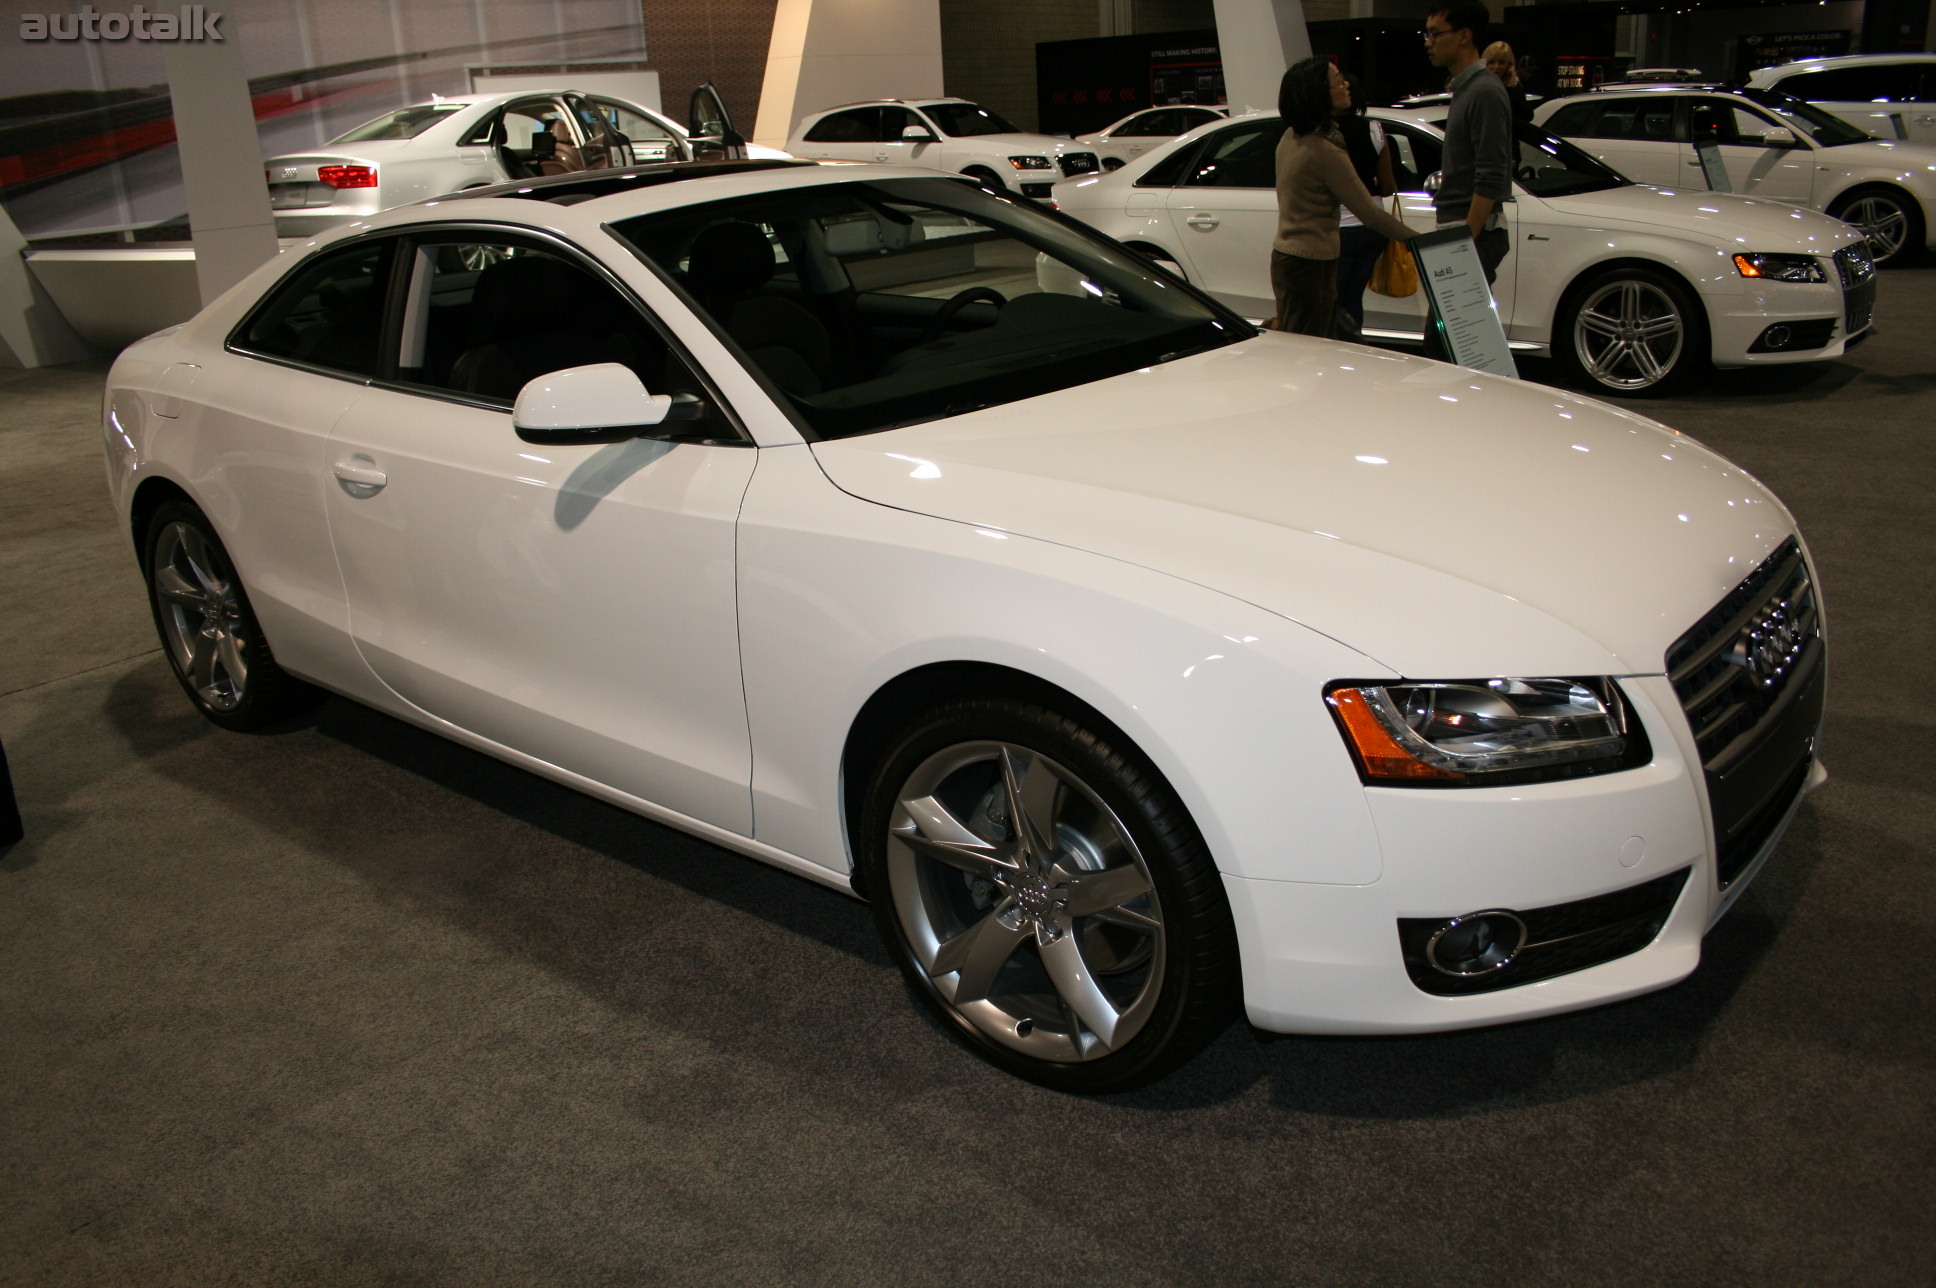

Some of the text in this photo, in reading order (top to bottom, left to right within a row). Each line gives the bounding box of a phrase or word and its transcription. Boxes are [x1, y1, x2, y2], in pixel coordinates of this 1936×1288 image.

[1151, 50, 1165, 58] STILL
[1166, 48, 1190, 56] MAKING
[1557, 65, 1568, 75] STOP
[1433, 269, 1446, 278] Audi
[1445, 266, 1453, 275] A5
